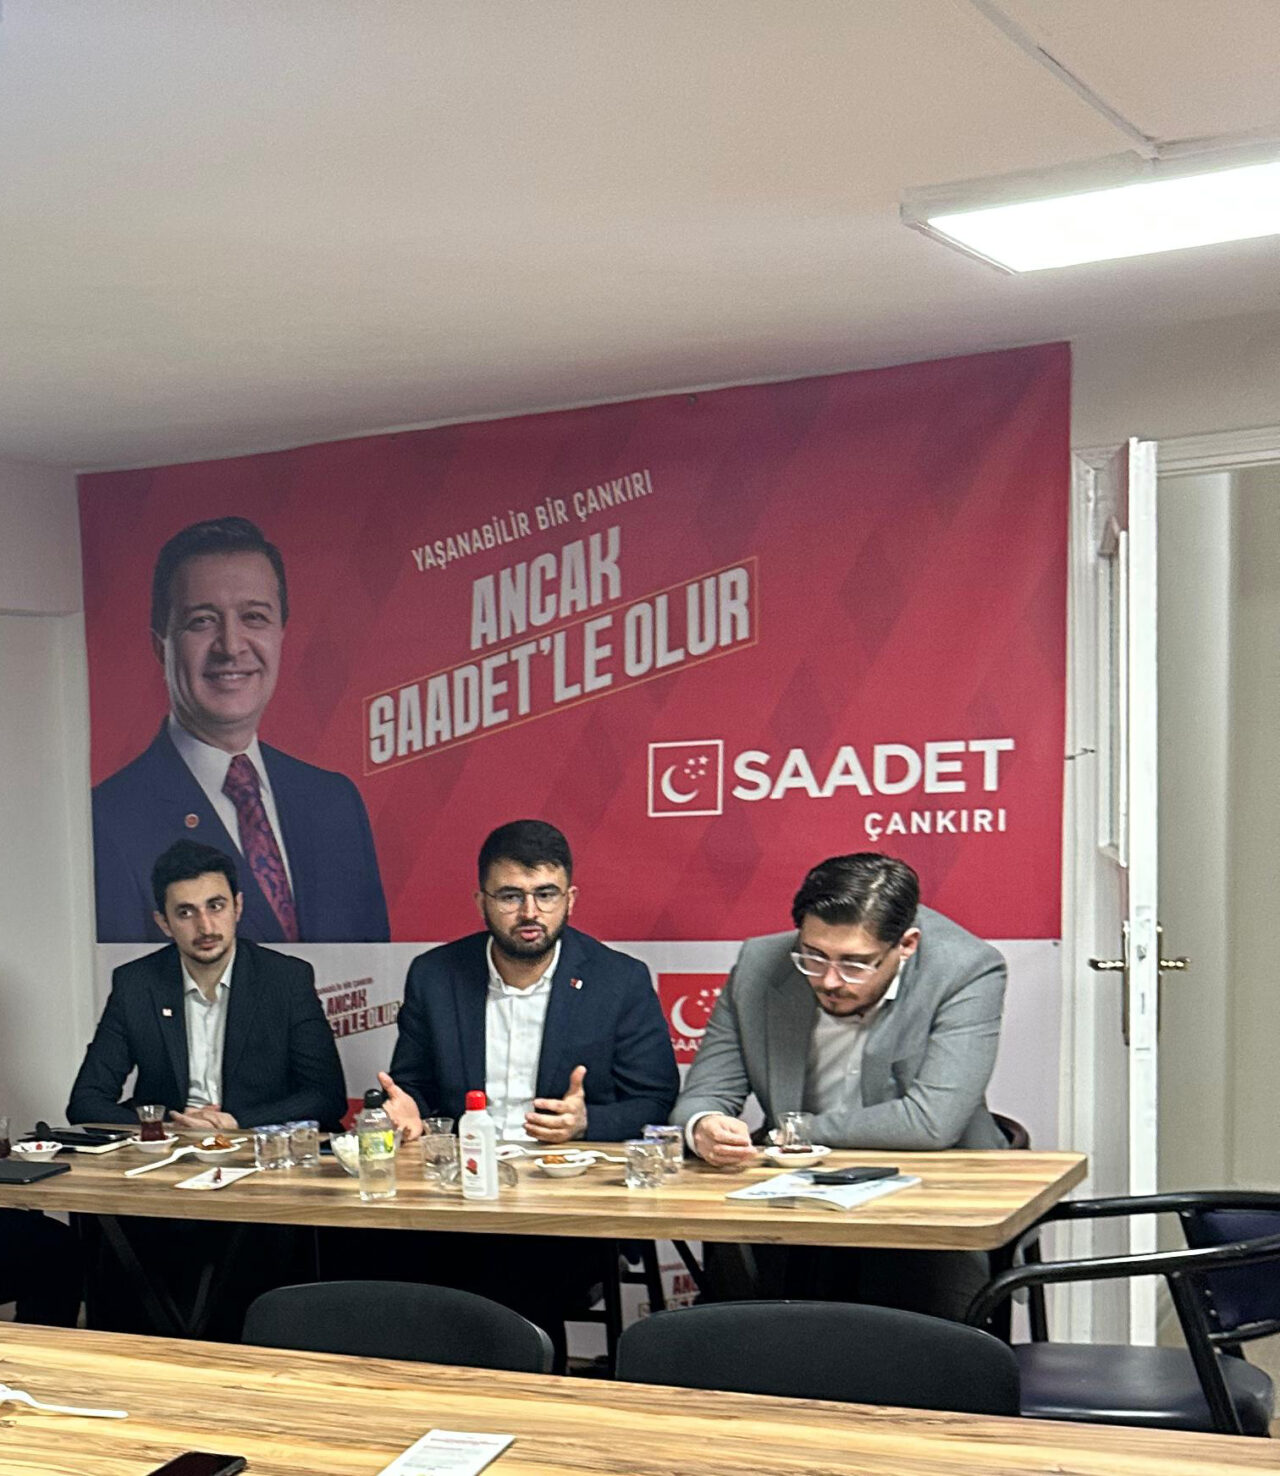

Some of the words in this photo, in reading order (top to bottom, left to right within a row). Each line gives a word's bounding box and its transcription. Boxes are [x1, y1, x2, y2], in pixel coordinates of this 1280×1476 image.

[411, 509, 531, 572] YAŞANABİLİR
[536, 497, 569, 530] BİR
[573, 469, 653, 522] ÇANKIRI
[470, 525, 622, 651] ANCAK
[369, 615, 613, 765] SAADET'LE
[624, 567, 750, 678] OLUR
[732, 738, 1015, 802] SAADET
[864, 808, 1007, 842] ÇANKIRI
